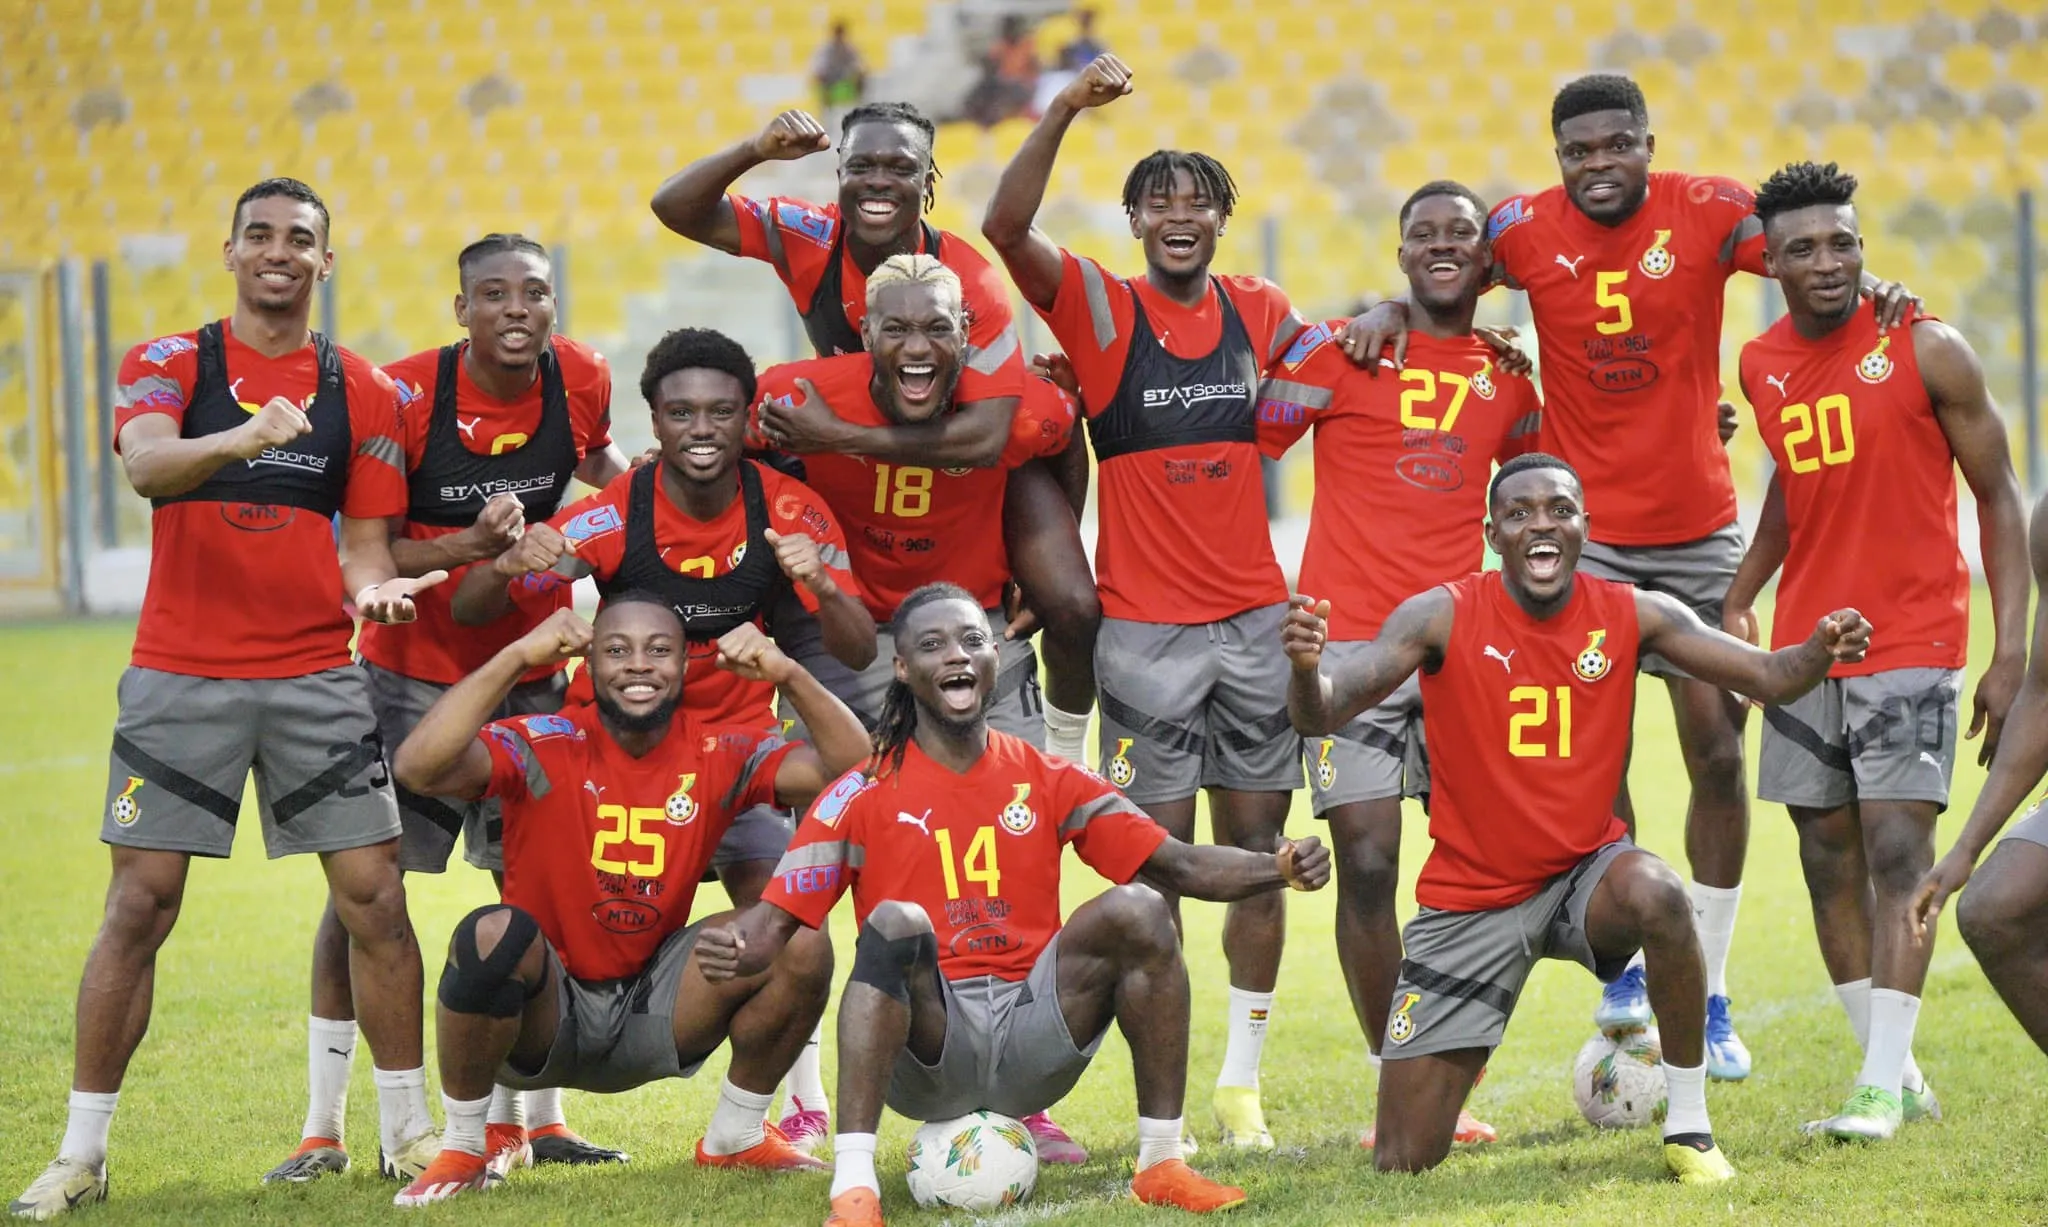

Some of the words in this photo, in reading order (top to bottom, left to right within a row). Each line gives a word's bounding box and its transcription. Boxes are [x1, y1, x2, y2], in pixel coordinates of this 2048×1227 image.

[1596, 270, 1633, 335] 5
[1604, 367, 1643, 384] MTN
[1400, 368, 1470, 432] 27
[1780, 393, 1855, 474] 20
[260, 448, 329, 469] Sports
[1412, 463, 1451, 482] MTN
[440, 473, 556, 501] STATSports
[874, 464, 933, 517] 18
[238, 504, 278, 519] MTN
[1508, 686, 1571, 757] 21
[591, 804, 666, 878] 25
[934, 825, 1001, 900] 14
[607, 909, 646, 925] MTN
[967, 935, 1008, 952] MTN
